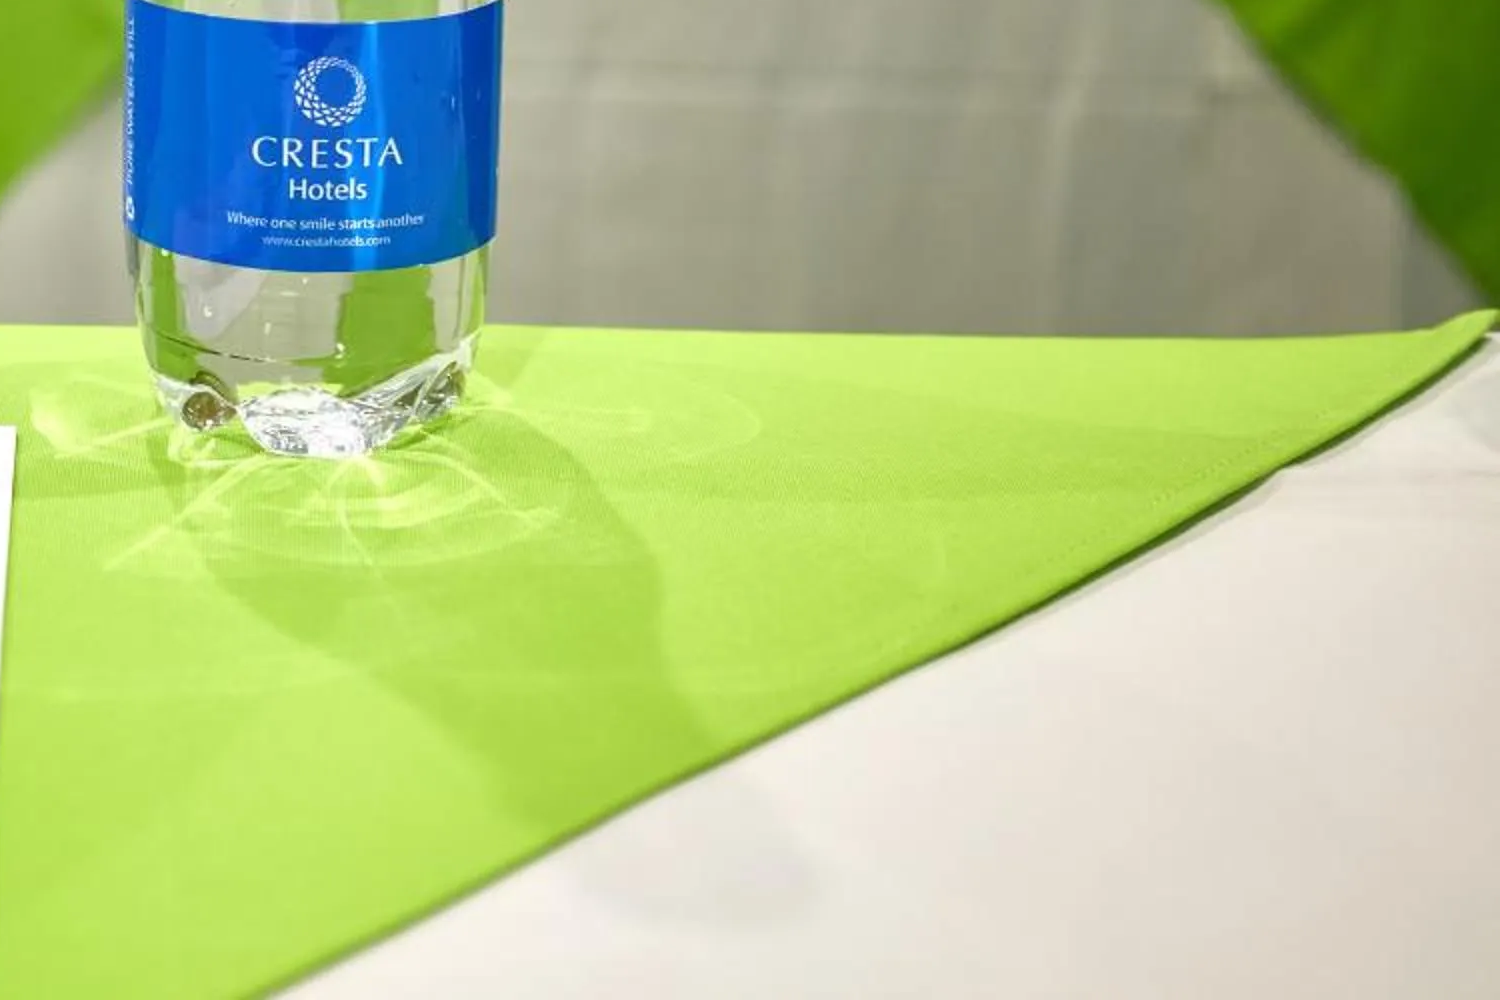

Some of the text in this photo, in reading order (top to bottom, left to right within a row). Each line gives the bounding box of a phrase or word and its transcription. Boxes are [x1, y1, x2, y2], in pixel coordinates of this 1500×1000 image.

[251, 135, 404, 169] CRESTA
[289, 177, 368, 201] Hotels
[226, 210, 424, 231] Where one smile starts another
[262, 235, 392, 248] www.crestahotels.com
